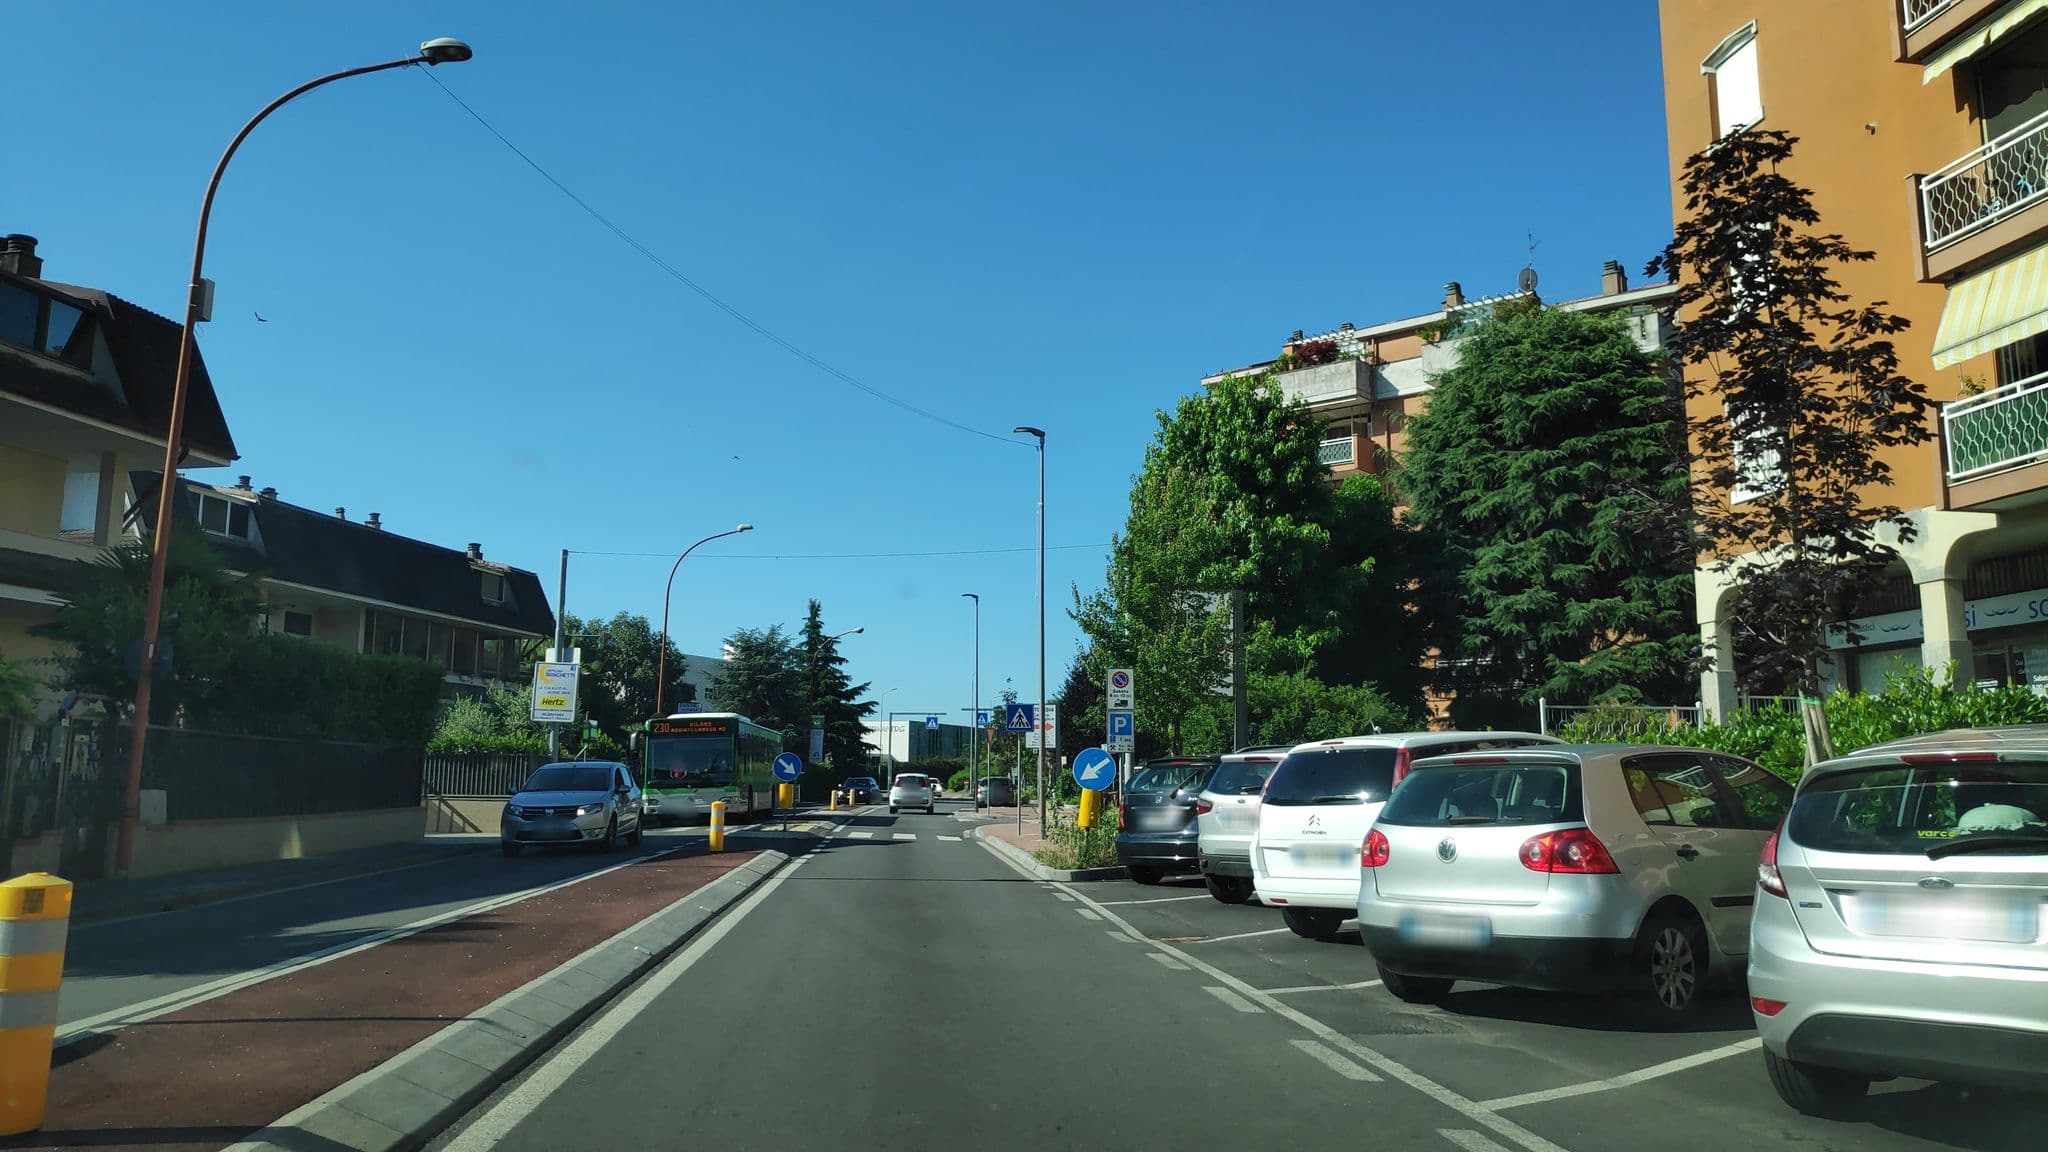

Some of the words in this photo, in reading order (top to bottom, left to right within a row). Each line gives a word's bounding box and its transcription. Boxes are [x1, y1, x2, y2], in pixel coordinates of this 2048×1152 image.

[541, 698, 564, 706] Hertz
[653, 722, 670, 733] 230
[1114, 716, 1127, 734] P
